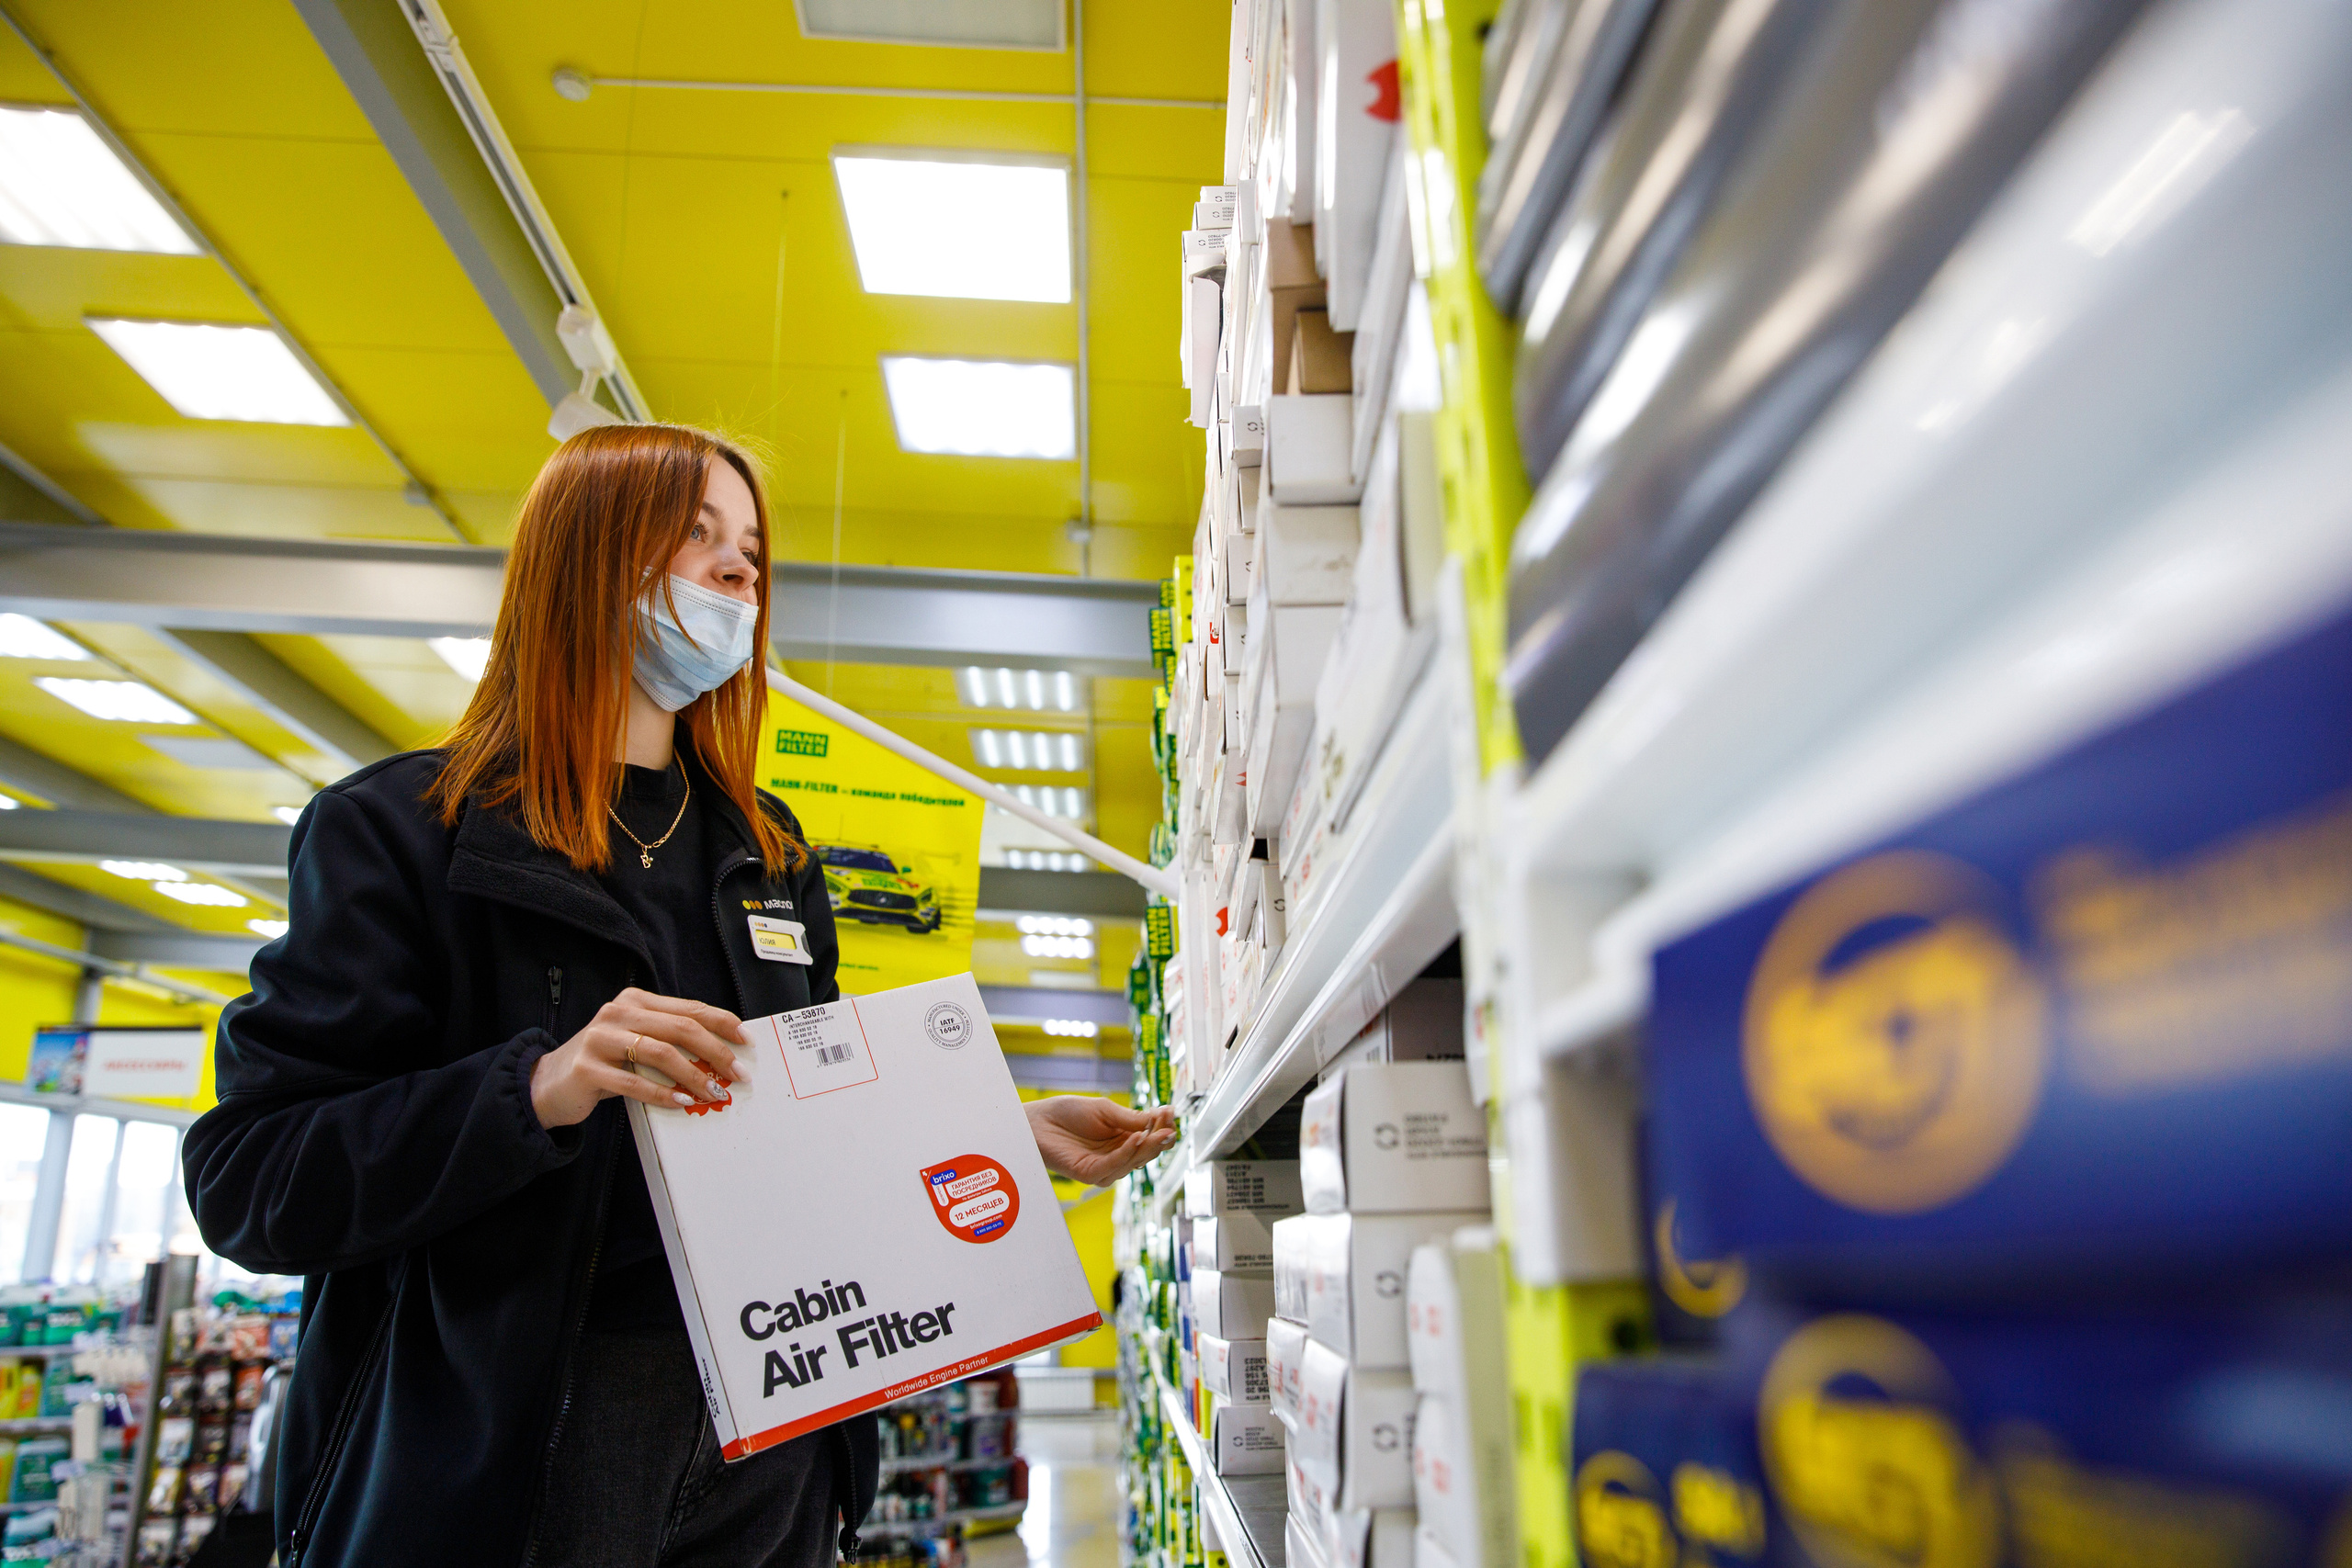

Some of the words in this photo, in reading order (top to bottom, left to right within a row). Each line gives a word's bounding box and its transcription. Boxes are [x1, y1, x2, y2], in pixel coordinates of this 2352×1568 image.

[1151, 609, 1161, 649] MANN
[779, 731, 827, 745] MANN
[778, 741, 826, 756] FILTER
[1147, 908, 1158, 955] MANN
[1158, 907, 1170, 955] FILTER
[789, 1019, 824, 1029] INTERCHANGEABLE
[940, 1018, 955, 1026] IATF
[940, 1025, 960, 1034] 16949
[933, 1172, 955, 1184] brixo
[951, 1175, 981, 1190] ГАРАНТИЯ
[981, 1171, 993, 1179] БЕЗ
[952, 1177, 997, 1197] ПОСРЕДНИКОВ
[955, 1213, 965, 1221] 12
[965, 1197, 1004, 1217] МЕСЯЦЕВ
[739, 1279, 867, 1342] Cabin
[762, 1341, 828, 1399] Air
[837, 1302, 956, 1370] Filter
[884, 1378, 929, 1400] Worldwide
[929, 1367, 958, 1382] Engine
[958, 1355, 989, 1373] Partner
